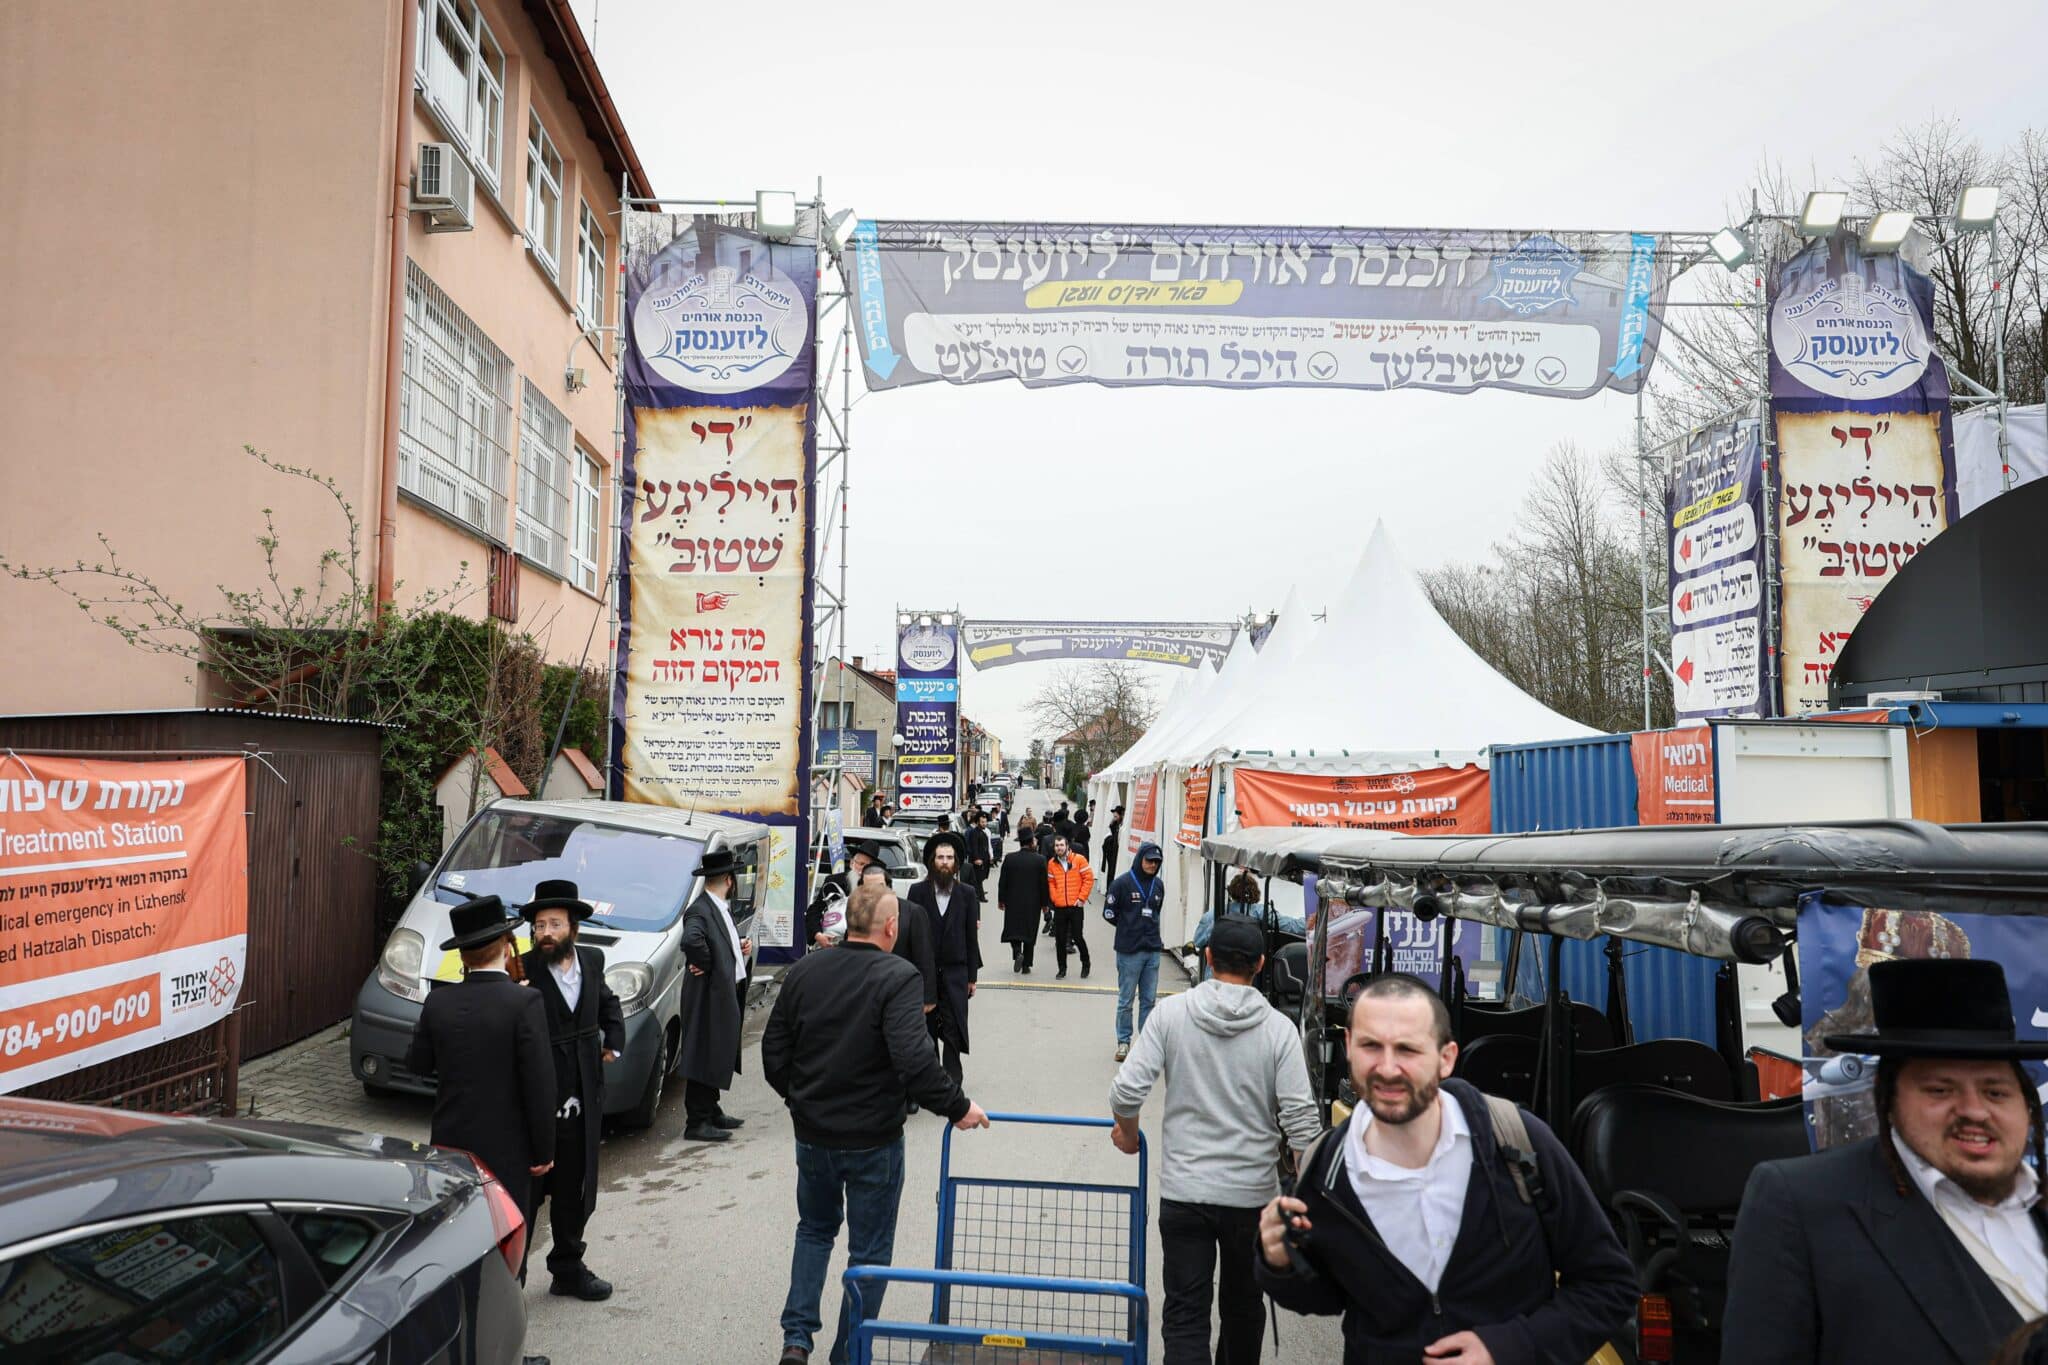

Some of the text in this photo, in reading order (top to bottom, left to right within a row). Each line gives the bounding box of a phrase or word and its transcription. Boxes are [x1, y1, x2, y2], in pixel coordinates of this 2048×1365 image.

[1150, 237, 1312, 286] אורחים
[1321, 244, 1471, 286] הכנסת
[1169, 286, 1208, 300] פאר
[682, 312, 762, 322] הכנסת אורחים
[1857, 319, 1893, 329] הכנסת
[1112, 318, 1128, 333] של
[675, 325, 768, 355] ליזענסק
[1291, 327, 1324, 341] במקום
[1811, 332, 1900, 360] ליזענסק
[1125, 342, 1297, 381] היכל תורה
[1370, 346, 1525, 389] שטיבלעך
[670, 628, 766, 651] מה נורא
[1132, 639, 1180, 655] אורחים
[653, 660, 780, 693] המקום הזה
[909, 680, 945, 693] מענער
[645, 695, 659, 704] של
[661, 697, 684, 708] קודש
[708, 697, 727, 705] ביתו
[729, 697, 744, 705] היה
[758, 696, 784, 709] המקום
[908, 711, 946, 723] הכנסת
[906, 726, 947, 737] אורחים
[757, 742, 780, 750] במקום
[1664, 744, 1706, 766] רפואי
[1665, 776, 1708, 792] Medical
[1288, 796, 1457, 817] נקודת טיפול רפואי
[1345, 819, 1410, 830] Treatment
[1413, 817, 1457, 828] Station
[112, 822, 184, 848] Station
[116, 873, 147, 887] רפואי
[149, 868, 188, 885] במקרה
[20, 885, 47, 900] חייגו
[34, 905, 113, 927] emergency
[118, 898, 131, 913] in
[135, 891, 187, 911] Lizhensk
[23, 934, 87, 959] Hatzalah
[92, 924, 157, 948] Dispatch:
[171, 970, 208, 991] איחוד
[172, 987, 208, 1008] הצלה
